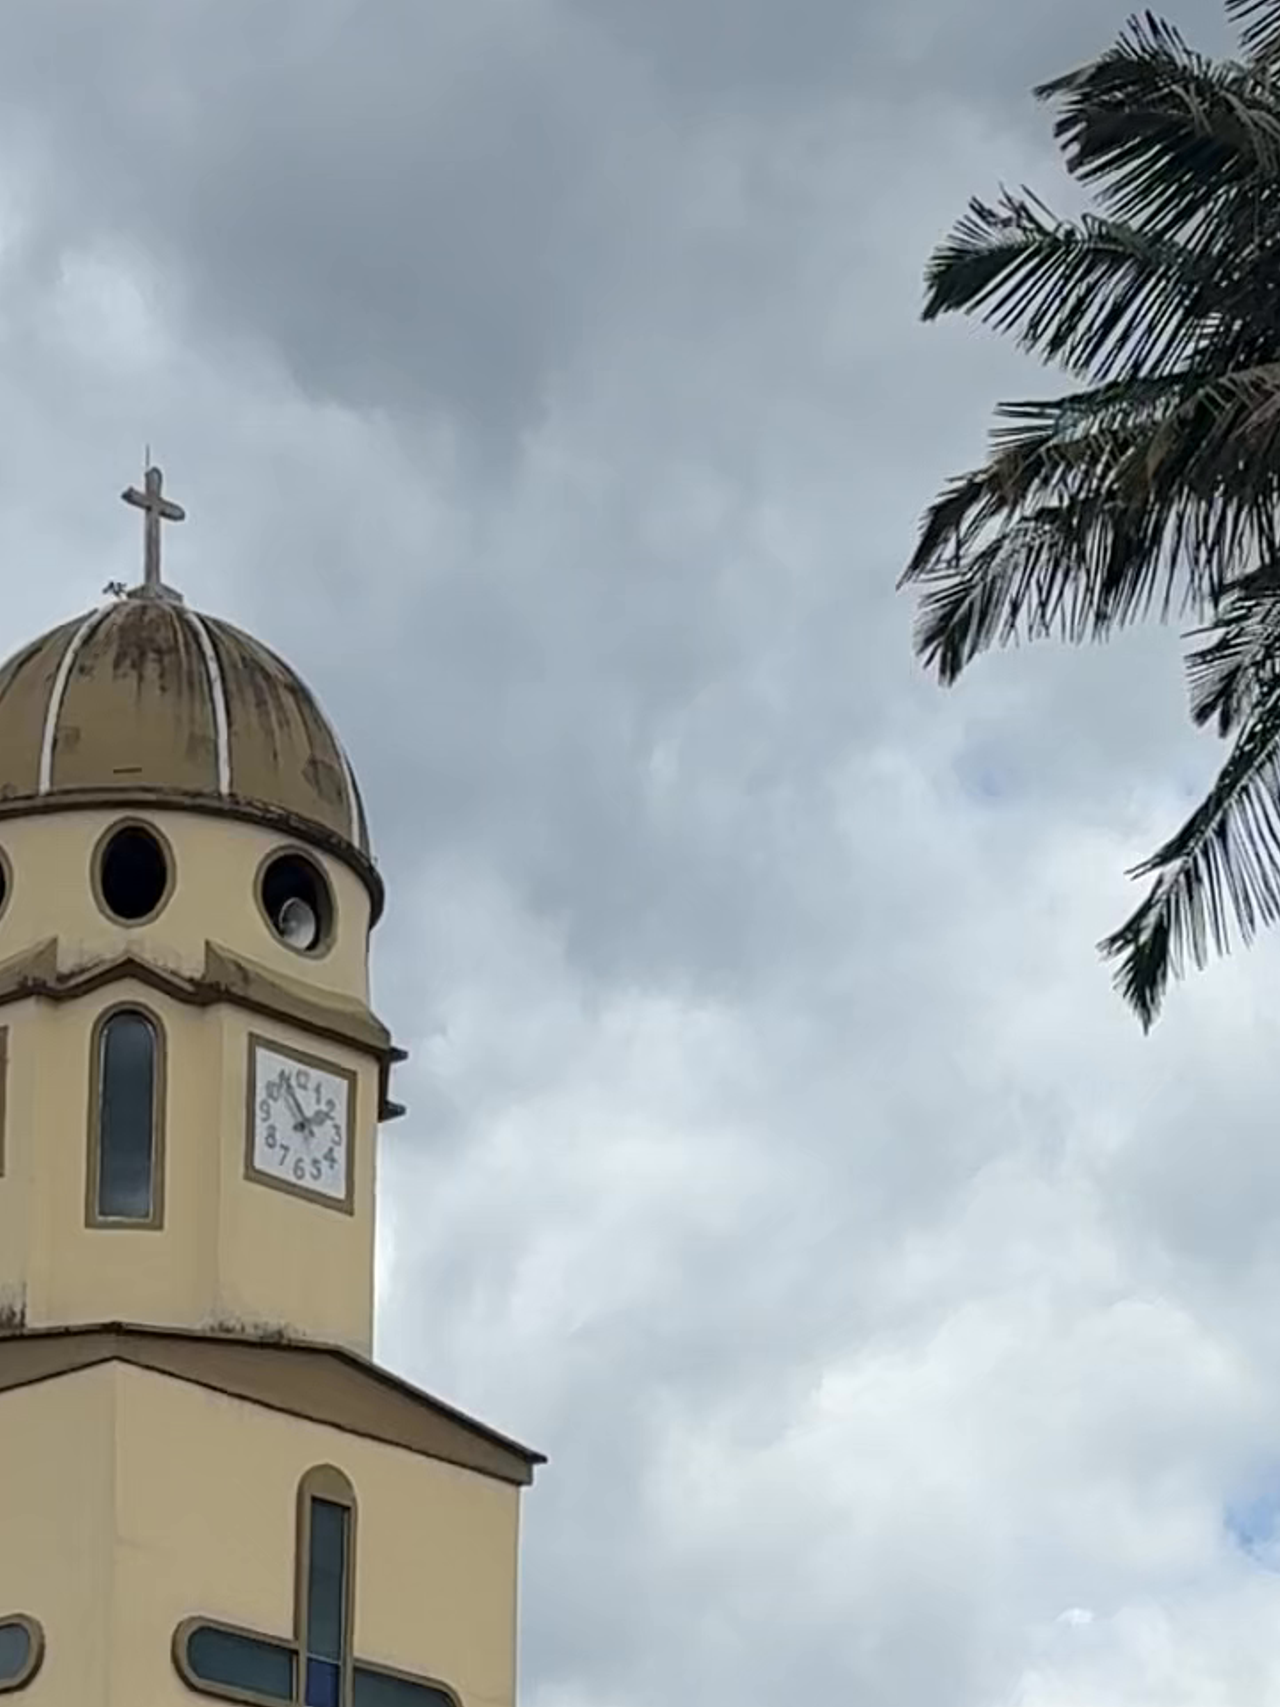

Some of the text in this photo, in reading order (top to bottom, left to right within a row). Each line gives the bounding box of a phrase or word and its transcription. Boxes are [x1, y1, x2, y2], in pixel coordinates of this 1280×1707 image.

[314, 1082, 322, 1105] 1
[259, 1098, 271, 1122] 9
[324, 1098, 336, 1121] 2
[265, 1124, 277, 1150] 8
[331, 1122, 342, 1147] 3
[279, 1142, 290, 1167] 7
[322, 1146, 338, 1170] 4
[293, 1156, 306, 1181] 6
[309, 1157, 322, 1181] 5
